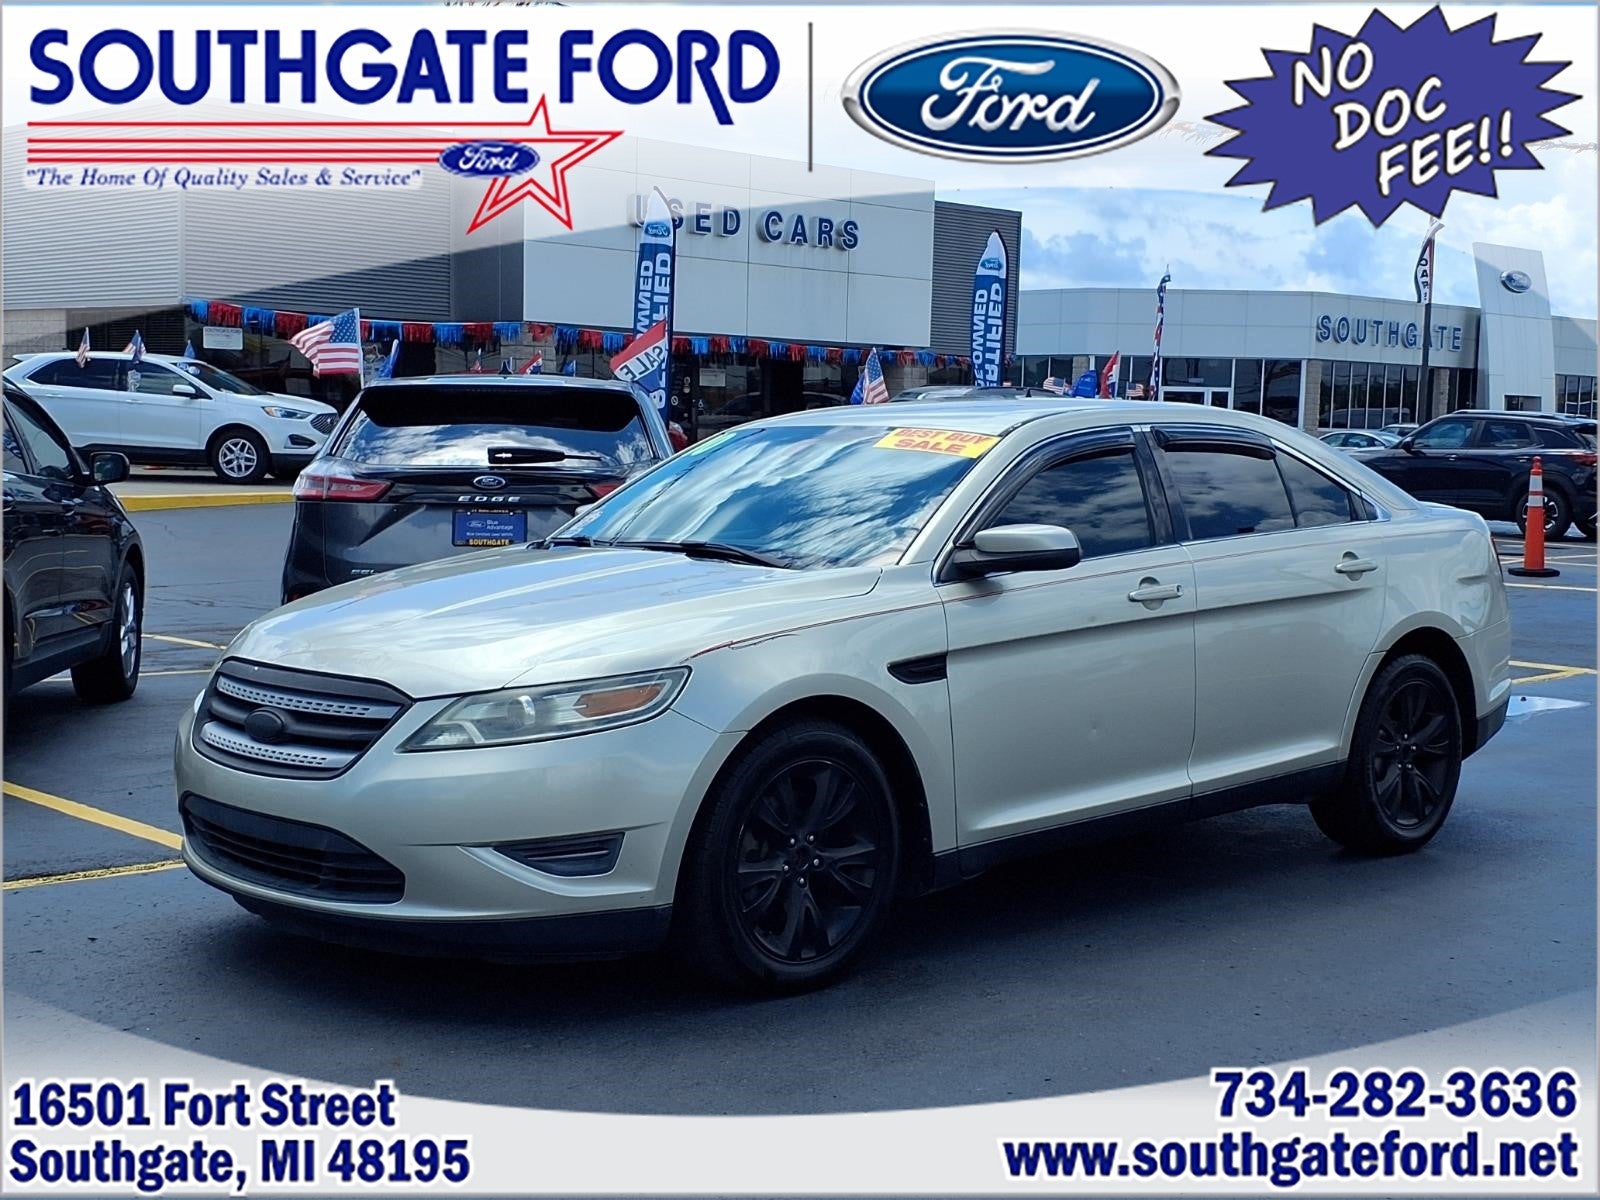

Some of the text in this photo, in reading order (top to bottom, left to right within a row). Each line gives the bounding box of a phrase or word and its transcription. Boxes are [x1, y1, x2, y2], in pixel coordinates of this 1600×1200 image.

[634, 194, 859, 250] USED CARS
[1319, 315, 1462, 350] SOUTHGTE
[894, 428, 991, 445] BEST BUY
[893, 438, 967, 454] SALE
[468, 538, 510, 546] SOUTHGATE
